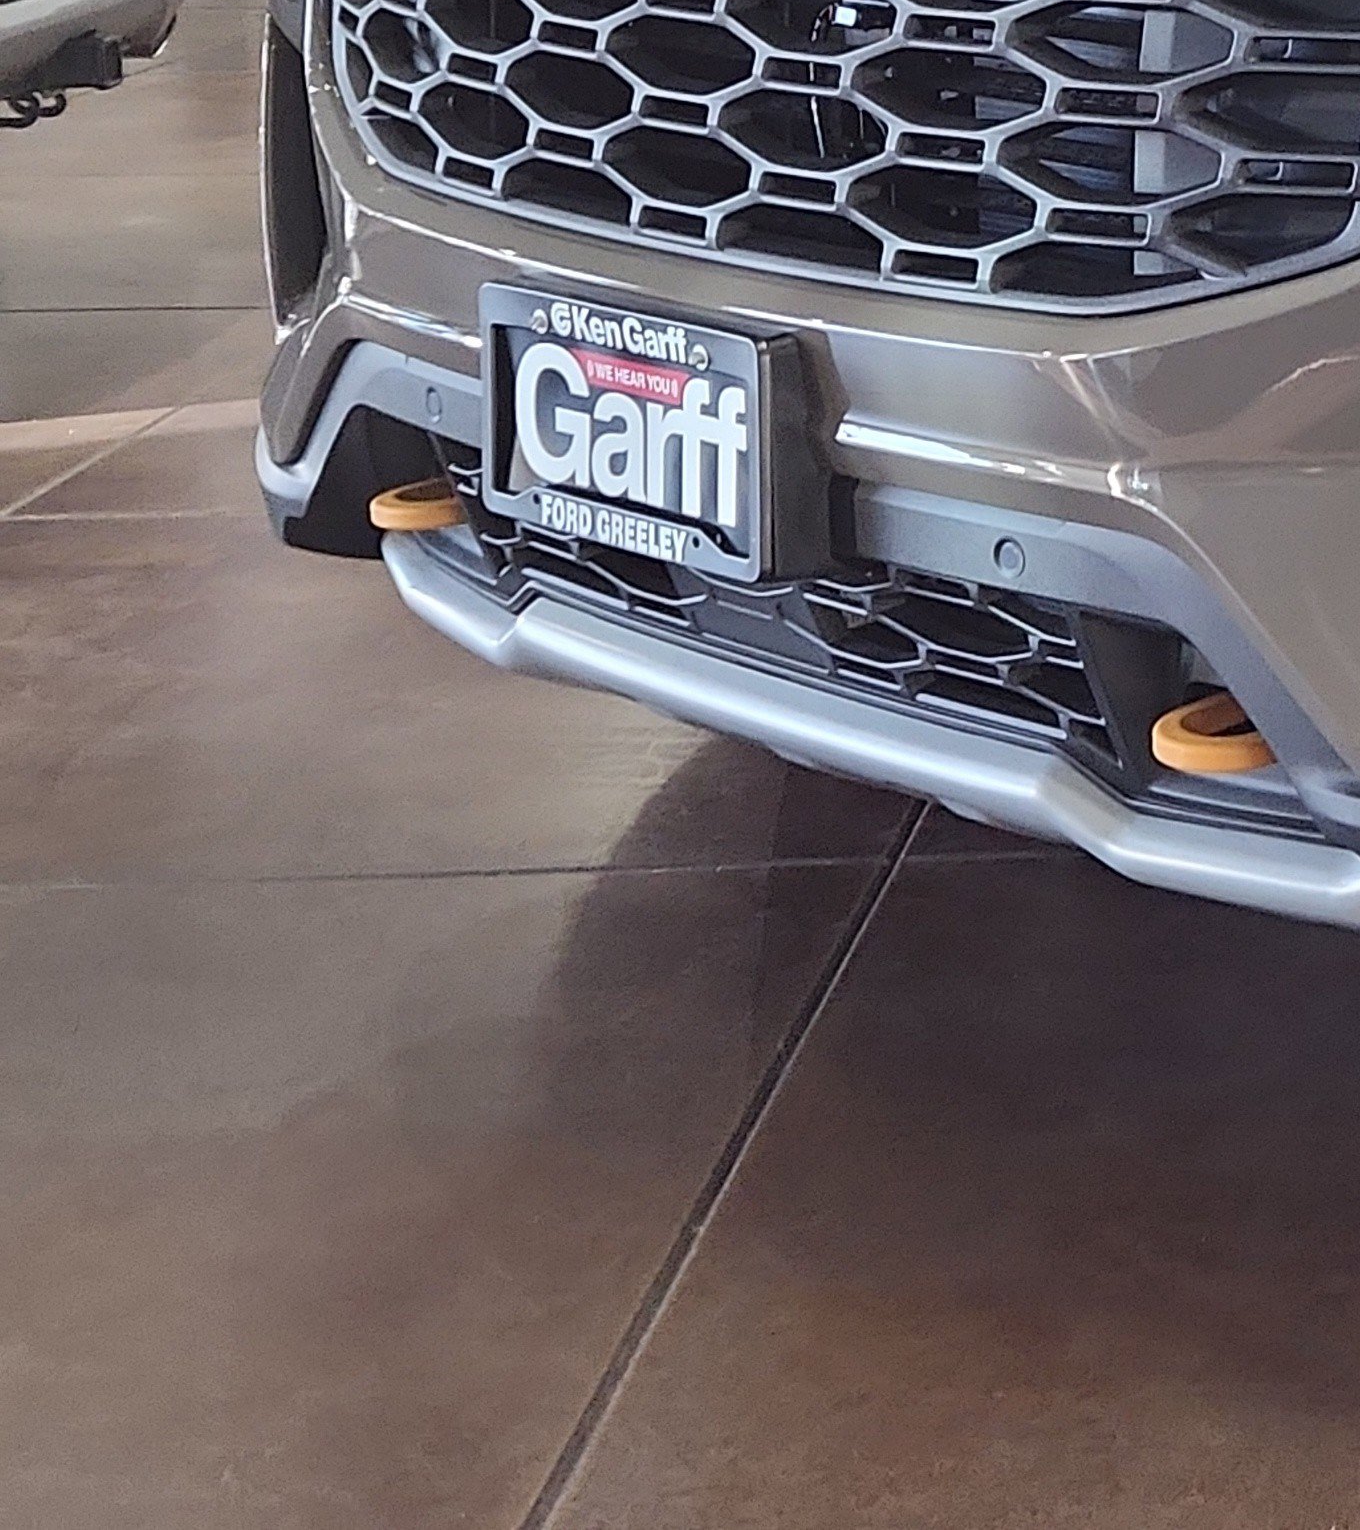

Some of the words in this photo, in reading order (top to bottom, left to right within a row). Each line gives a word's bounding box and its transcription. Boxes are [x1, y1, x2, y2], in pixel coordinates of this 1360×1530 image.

[572, 304, 623, 348] Ken
[622, 317, 688, 365] Garff
[595, 362, 614, 381] WE
[614, 364, 645, 389] HEAR
[645, 372, 671, 395] YOU
[515, 343, 747, 527] Garff
[540, 492, 589, 534] FORD
[597, 507, 688, 563] GREELEY
